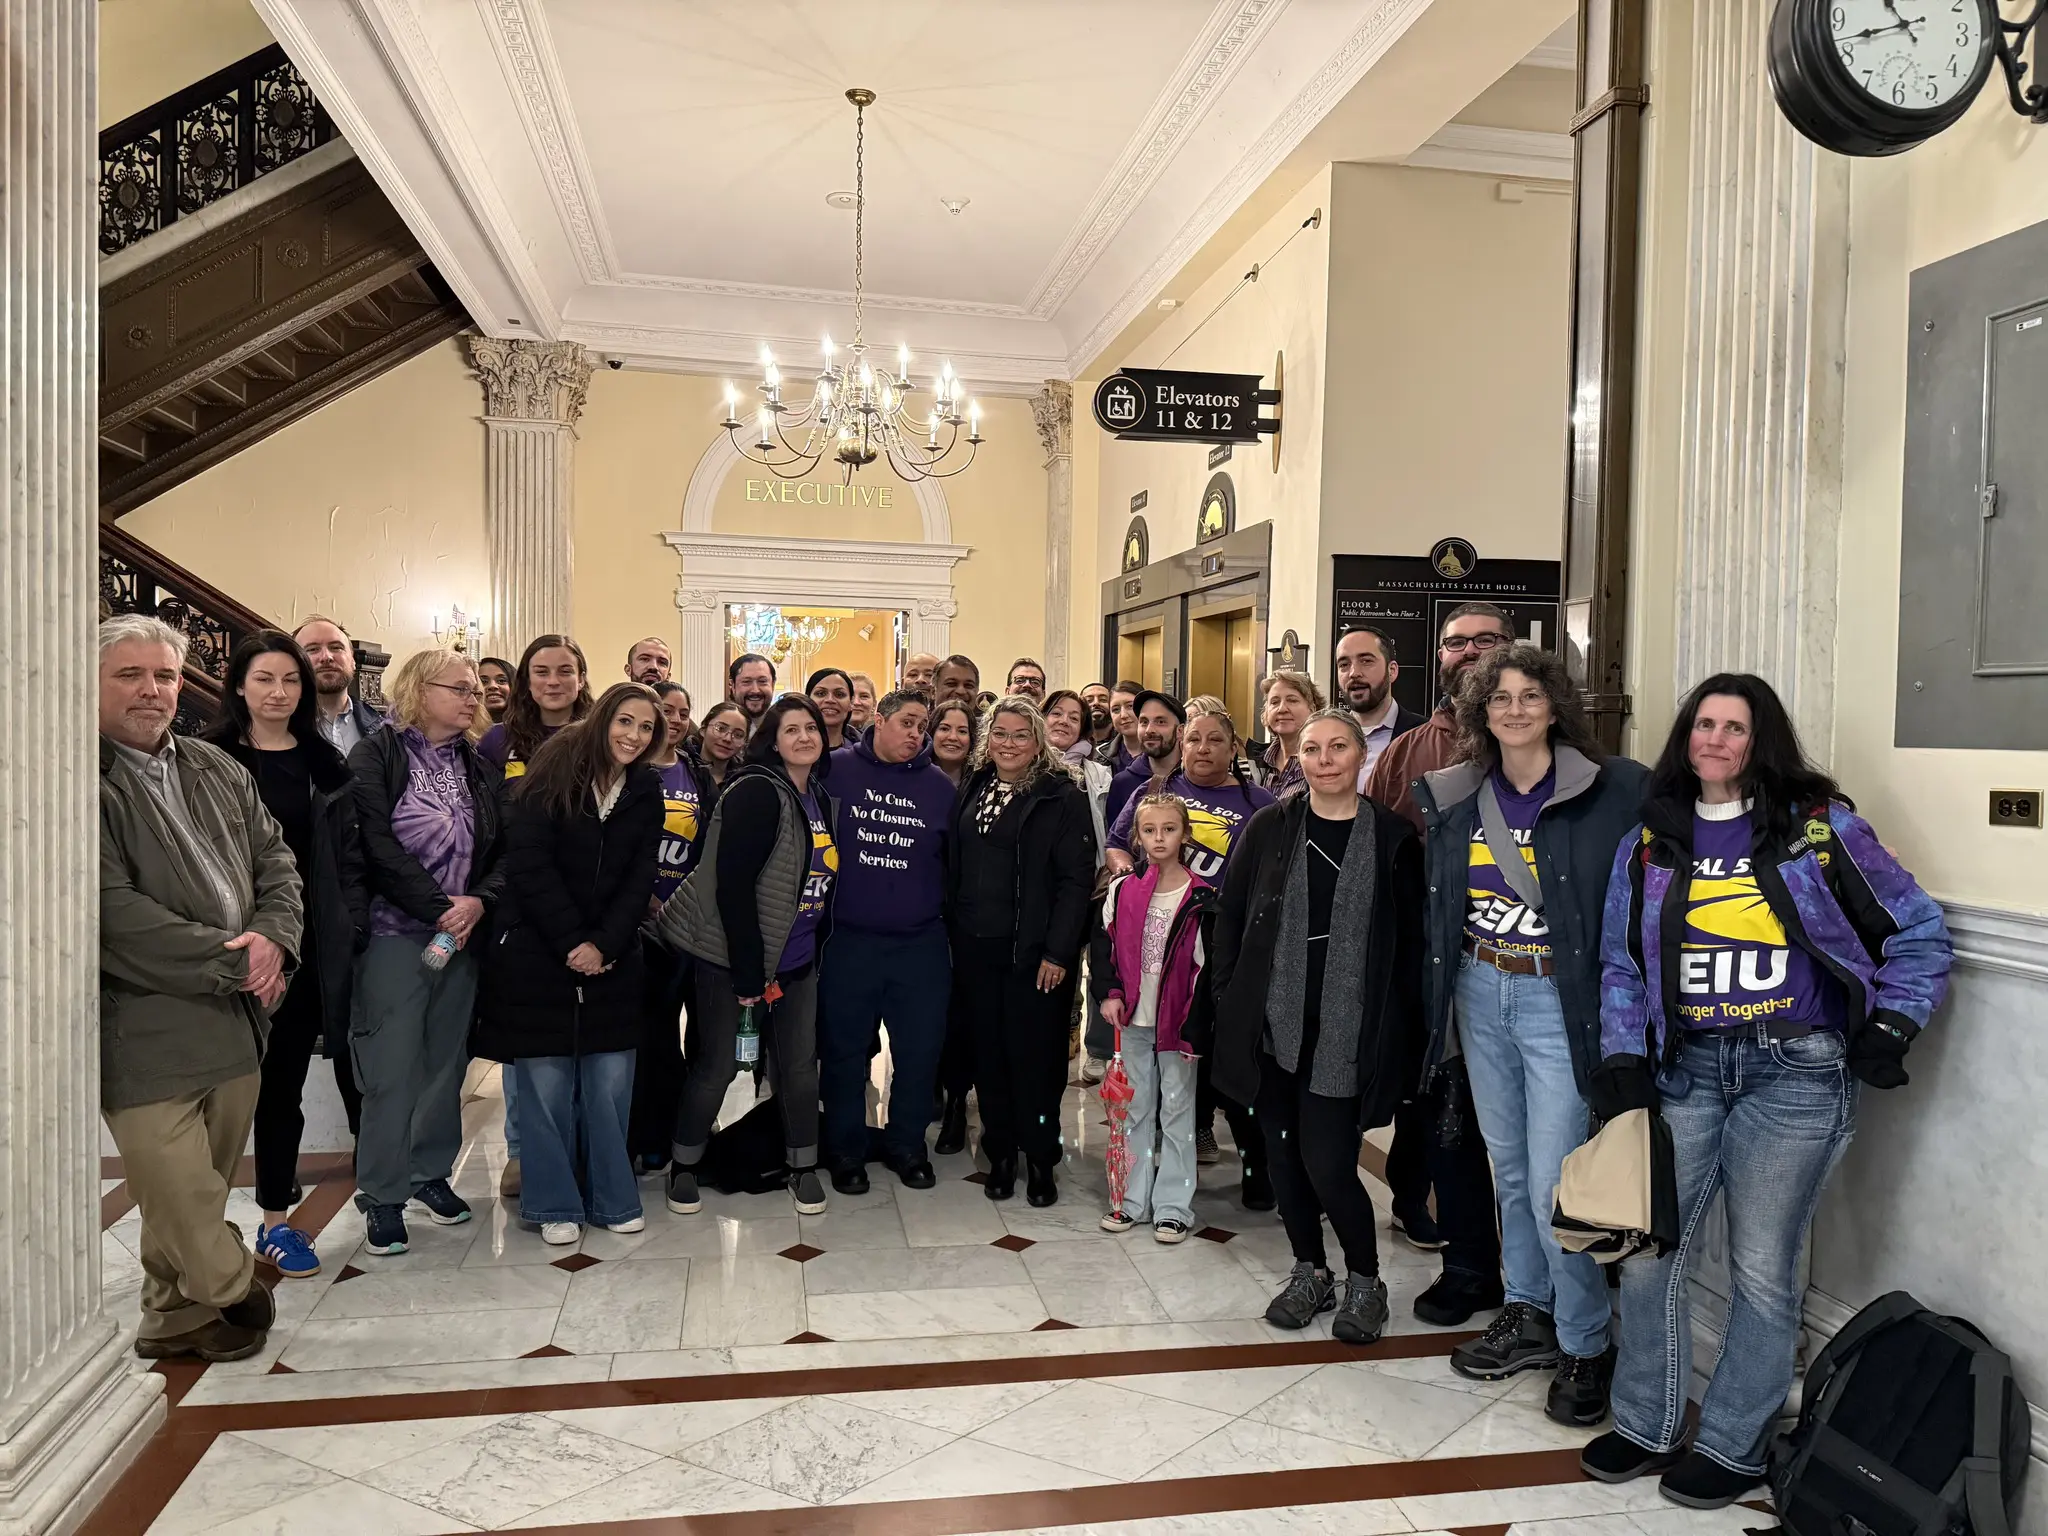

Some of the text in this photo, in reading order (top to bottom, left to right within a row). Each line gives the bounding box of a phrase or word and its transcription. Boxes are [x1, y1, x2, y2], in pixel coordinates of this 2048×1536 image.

[1832, 7, 1846, 31] 9
[1955, 23, 1969, 47] 3
[1839, 41, 1854, 67] 8
[1945, 54, 1958, 78] 4
[1861, 69, 1873, 91] 7
[1925, 75, 1938, 100] 5
[1892, 81, 1905, 105] 6
[1155, 385, 1240, 408] Elevators
[1156, 410, 1232, 430] 11 & 12
[745, 479, 893, 509] EXECUTIVE
[1378, 581, 1459, 589] MASSACHUSETTS
[1341, 601, 1371, 609] FLOOR
[864, 788, 917, 810] No Cuts,
[849, 805, 926, 828] No Closures.
[1212, 806, 1243, 820] 509
[857, 826, 915, 848] Save Our
[1787, 835, 1810, 855] HARLEY
[858, 849, 909, 870] Services
[1719, 996, 1795, 1020] Together
